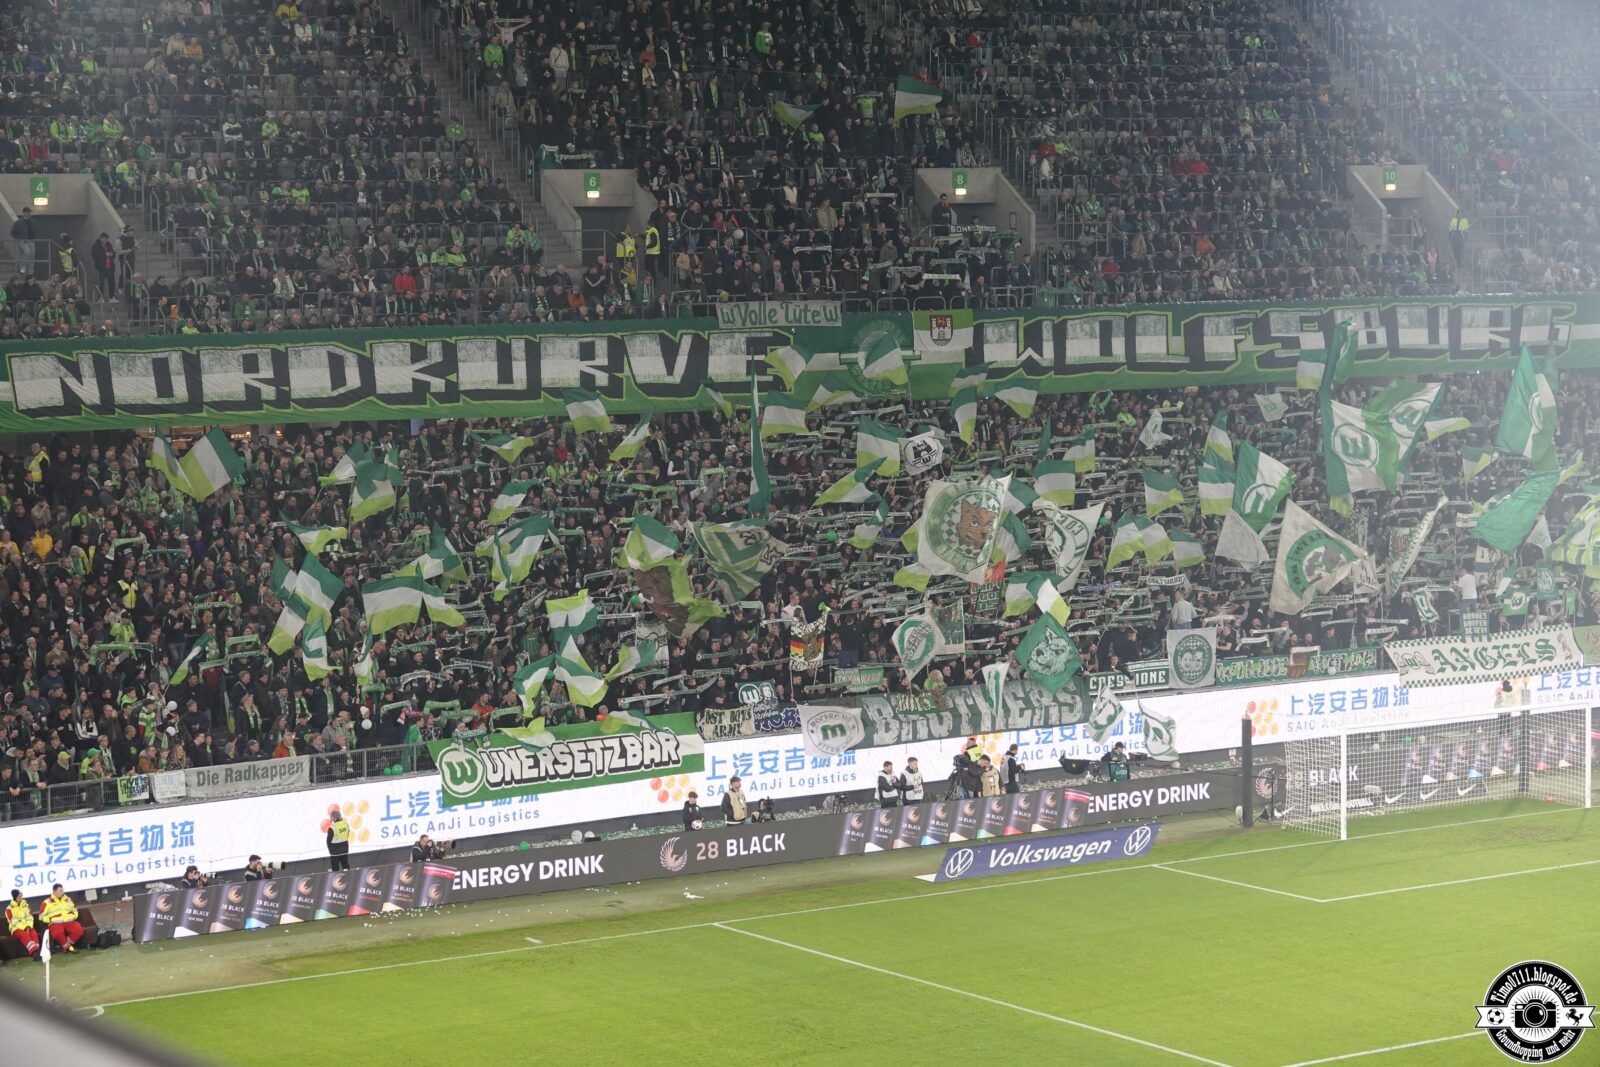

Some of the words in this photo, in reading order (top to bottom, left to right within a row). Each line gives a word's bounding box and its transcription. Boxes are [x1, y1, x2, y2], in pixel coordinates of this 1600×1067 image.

[35, 182, 45, 193] 4
[589, 176, 597, 187] 6
[956, 174, 964, 185] 8
[1384, 171, 1396, 181] 10
[734, 302, 778, 326] Volle
[9, 332, 778, 411] NORDKURVE
[980, 303, 1574, 367] WOLFSBURG
[1431, 638, 1557, 674] ANGELS
[196, 770, 220, 787] Die
[224, 760, 304, 785] Radkappen
[481, 731, 680, 788] UNERSETZBAR
[750, 777, 783, 793] AnJi
[789, 771, 857, 788] Logistics
[1087, 788, 1154, 815] ENERGY
[1157, 782, 1210, 806] DRINK
[380, 823, 419, 839] SAIC
[426, 817, 462, 833] AnJi
[468, 808, 541, 828] Logistics
[13, 820, 195, 869] 上汽安吉物流
[695, 841, 719, 861] 28
[726, 832, 786, 858] BLACK
[989, 838, 1112, 869] Volkswagen
[14, 869, 57, 888] SAIC
[66, 863, 106, 881] AnJi
[115, 853, 196, 875] Logistics
[452, 862, 535, 891] ENERGY
[540, 854, 604, 878] DRINK
